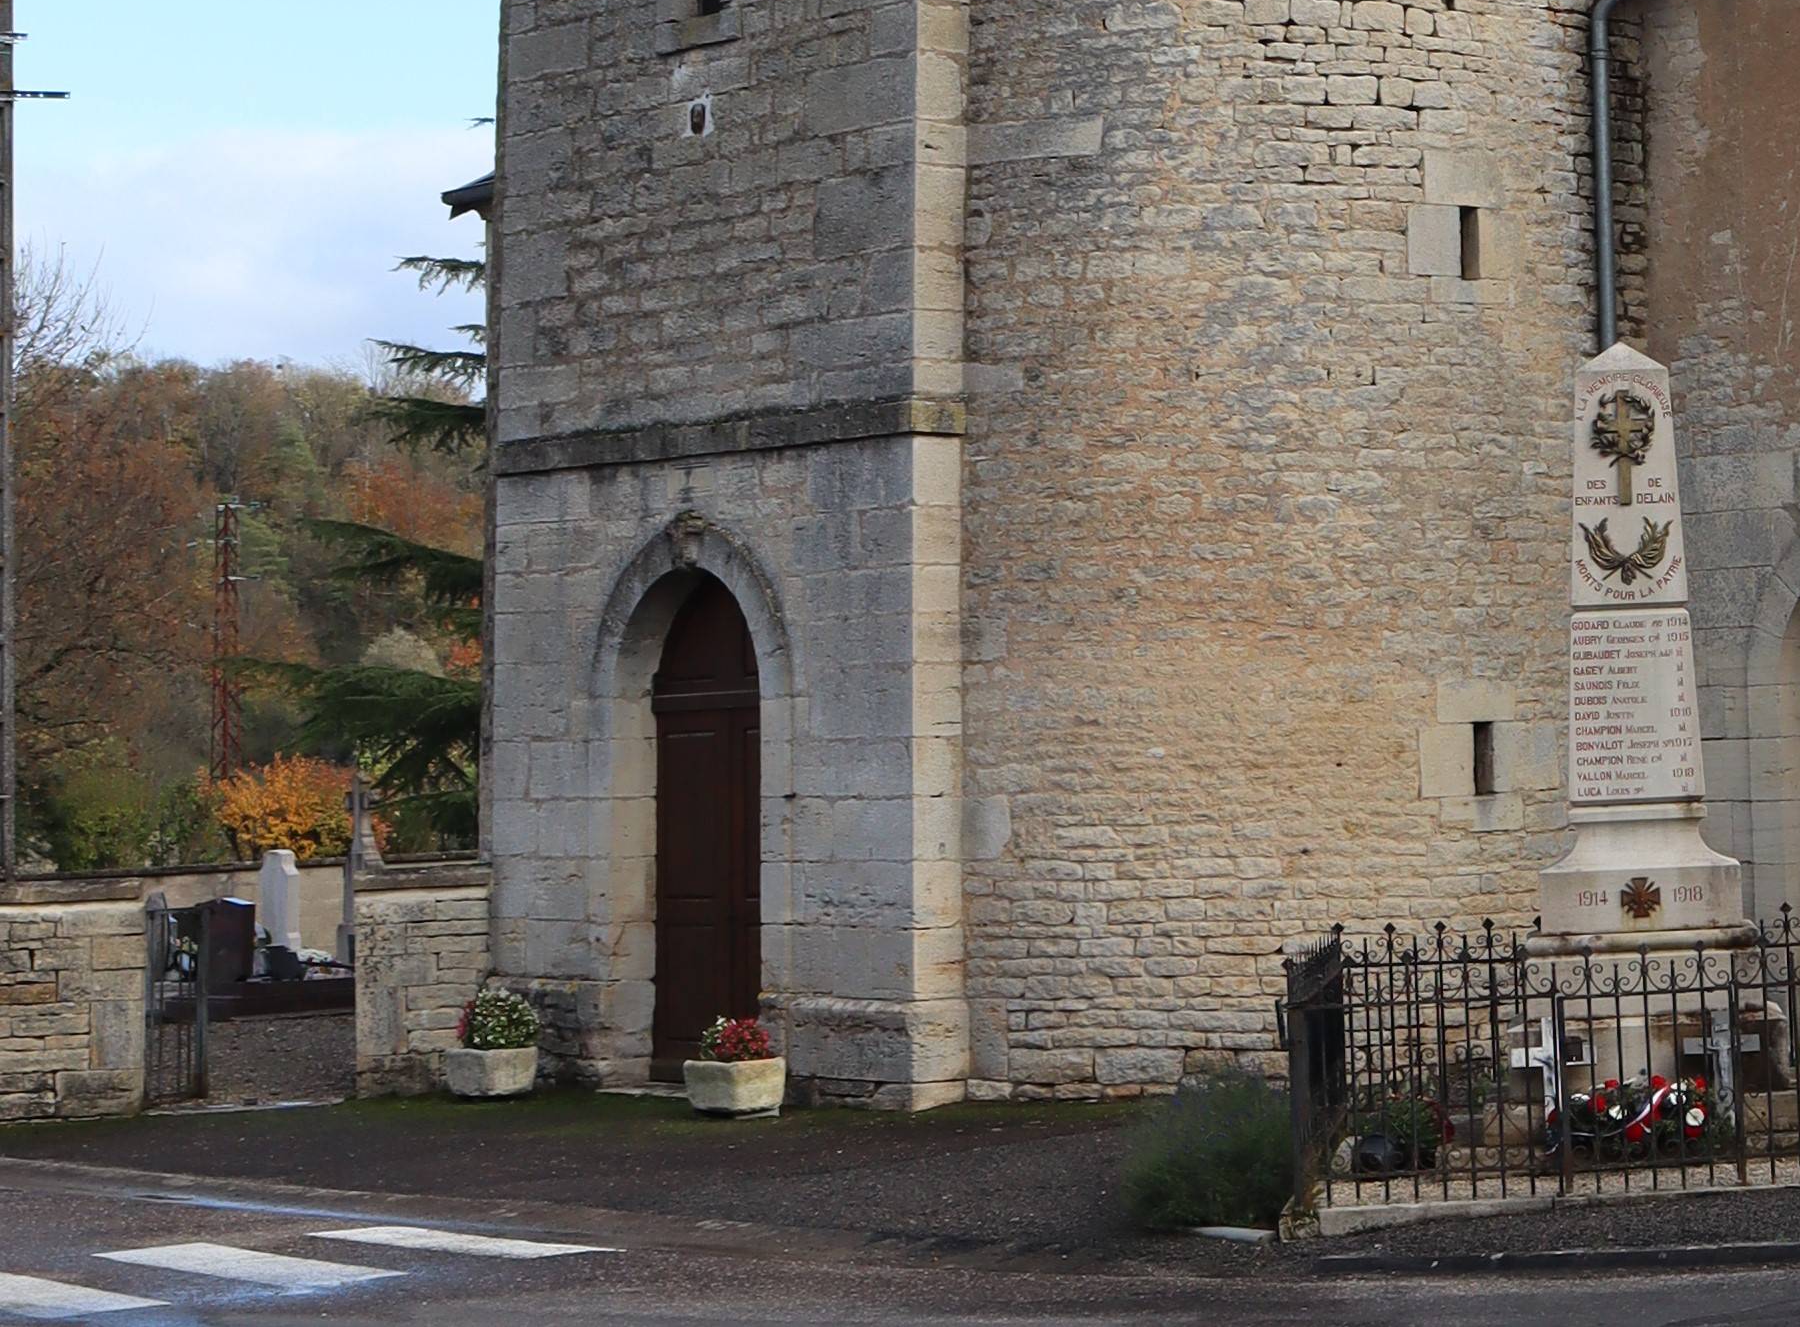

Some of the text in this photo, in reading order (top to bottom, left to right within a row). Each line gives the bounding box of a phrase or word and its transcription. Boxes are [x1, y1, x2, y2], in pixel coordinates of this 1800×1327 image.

[1580, 398, 1589, 411] LA
[1632, 374, 1673, 419] GLORIEUSE
[1587, 480, 1607, 490] DES
[1647, 478, 1662, 488] DE
[1575, 495, 1620, 506] ENFANTS
[1636, 492, 1676, 504] DELAIN
[1575, 555, 1682, 600] MORTS POUR LA PATRIE
[1571, 620, 1609, 631] GODARD
[1666, 616, 1688, 626] 1914
[1573, 635, 1603, 646] AUBRY
[1667, 631, 1689, 642] 1915
[1573, 665, 1605, 676] GAGEY
[1574, 696, 1607, 706] DUBOIS
[1575, 711, 1600, 721] DAVID
[1575, 725, 1622, 736] CHAMPION
[1576, 740, 1624, 752] BONVALOT
[1577, 755, 1623, 766] CHAMPION
[1577, 771, 1612, 781] VALLON
[1672, 767, 1694, 778] 1918
[1577, 787, 1602, 797] LUCA
[1578, 890, 1608, 906] 1914
[1673, 885, 1703, 902] 1918
